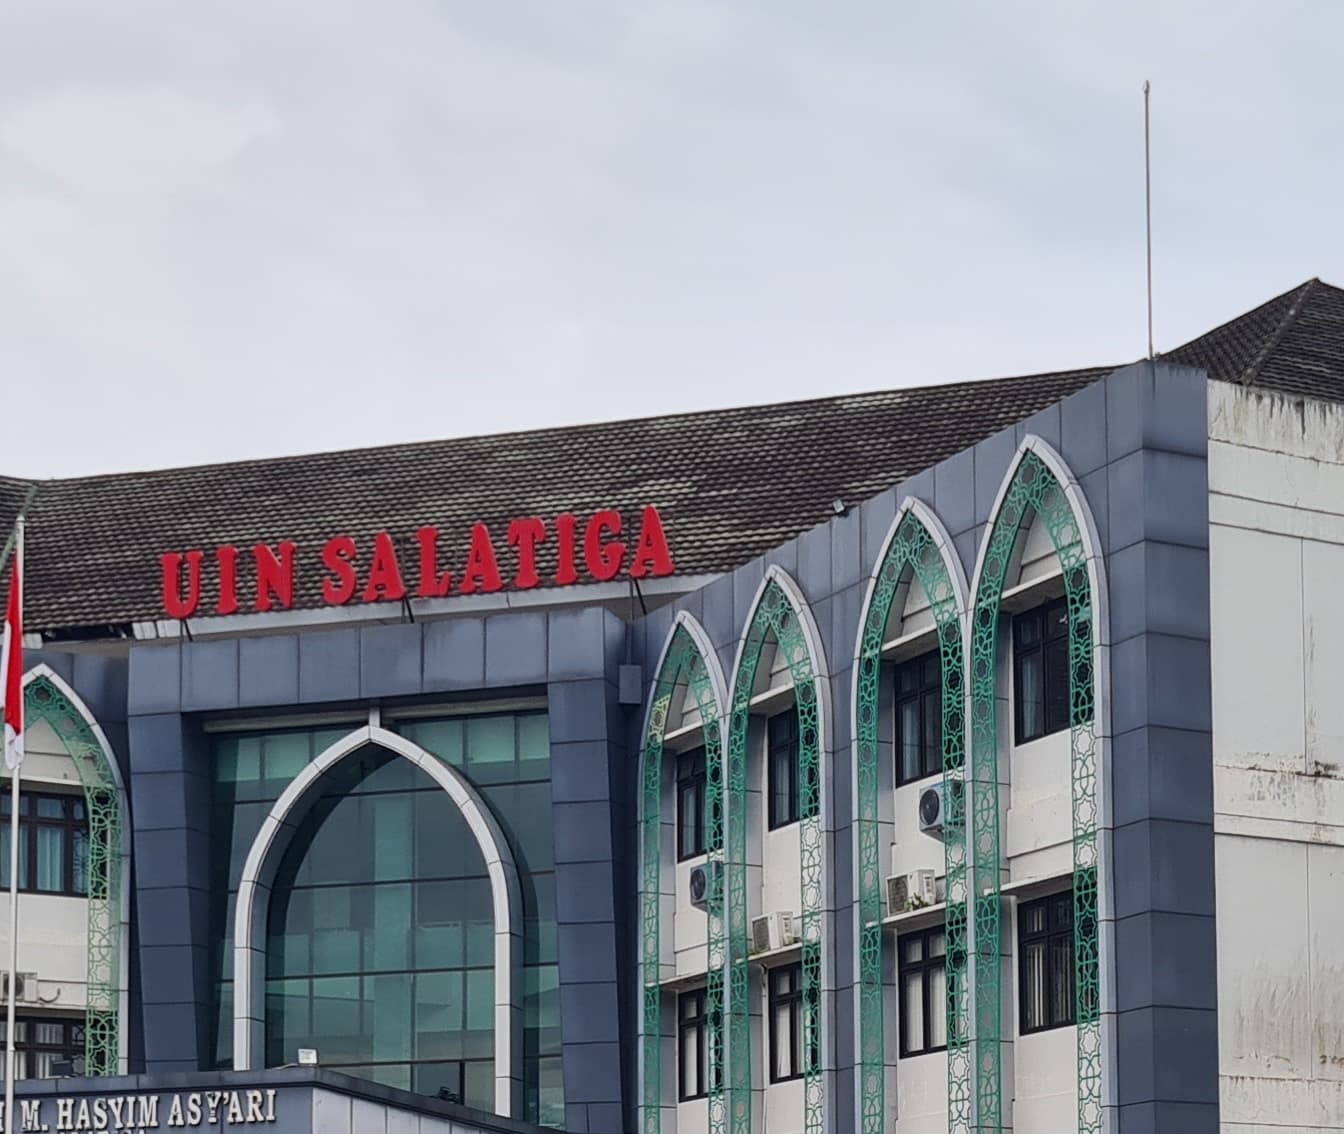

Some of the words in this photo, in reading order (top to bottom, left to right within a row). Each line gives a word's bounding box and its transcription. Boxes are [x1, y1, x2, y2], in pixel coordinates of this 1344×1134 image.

[161, 541, 296, 618] UIN
[321, 504, 673, 604] SALATIGA
[57, 1096, 159, 1130] HASYIM
[167, 1089, 276, 1126] ASY'ARI
